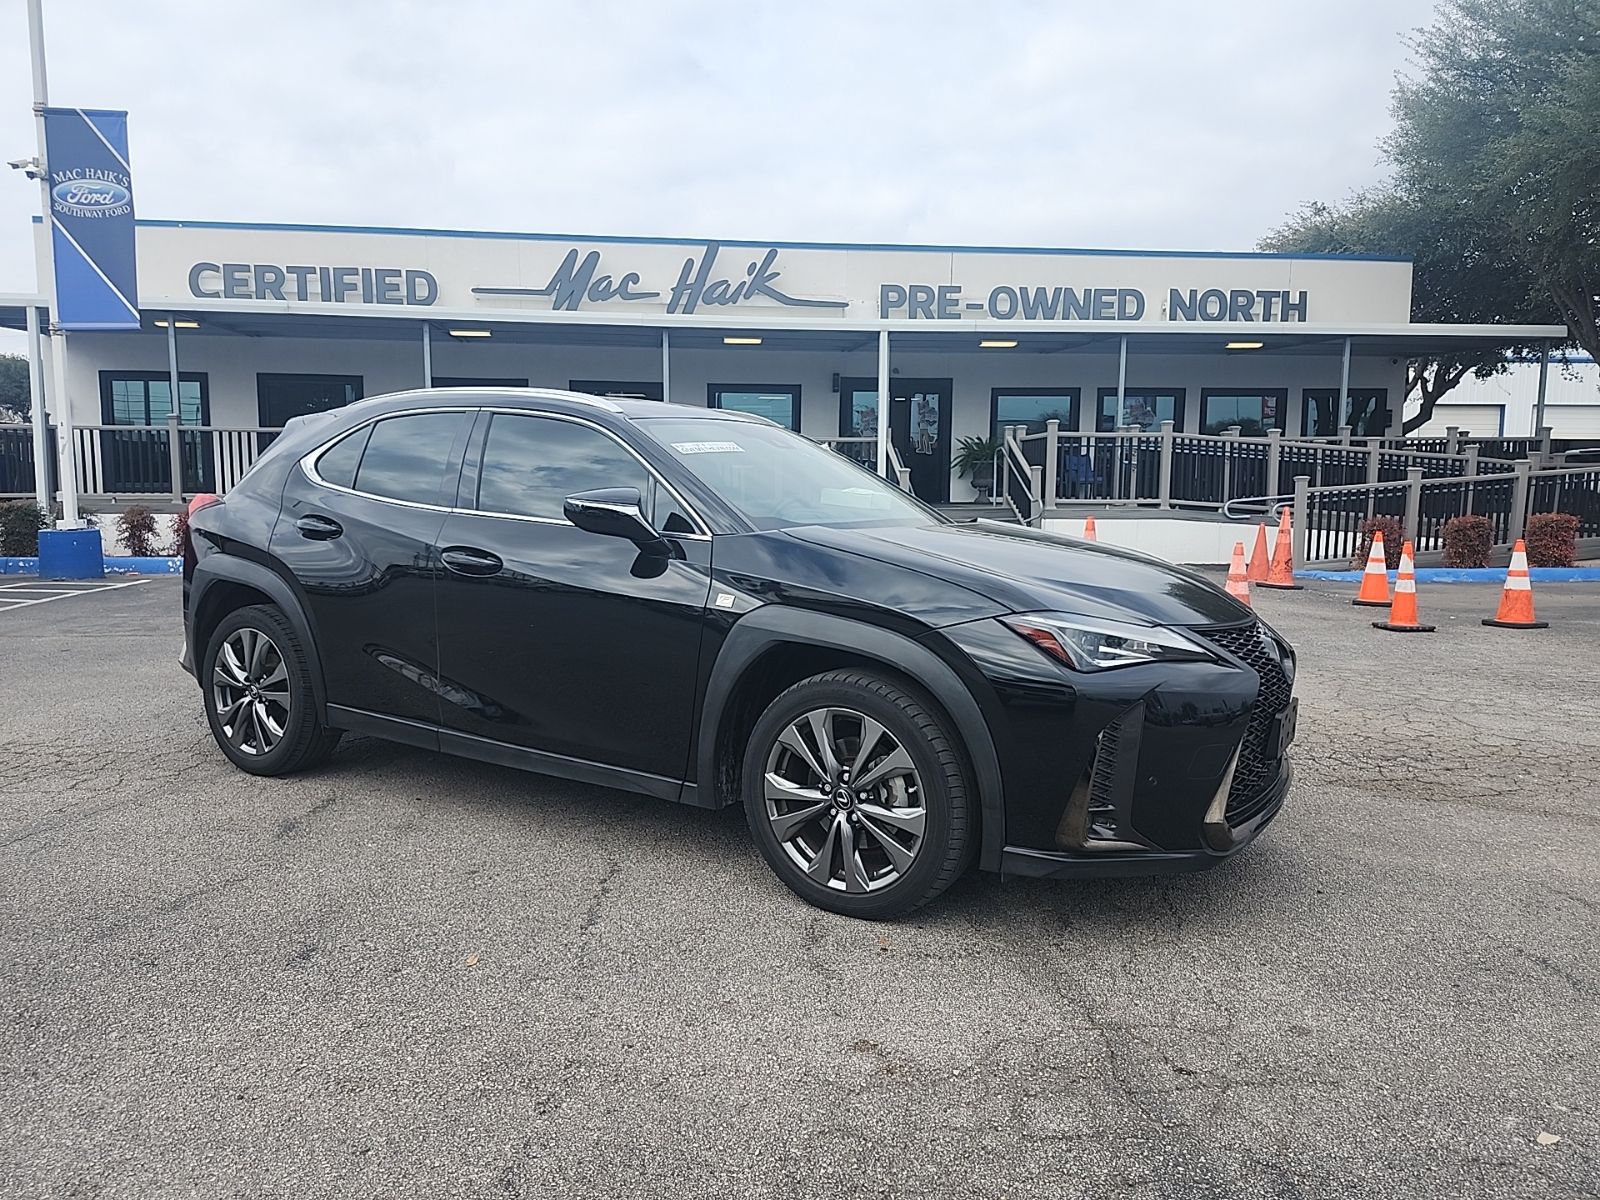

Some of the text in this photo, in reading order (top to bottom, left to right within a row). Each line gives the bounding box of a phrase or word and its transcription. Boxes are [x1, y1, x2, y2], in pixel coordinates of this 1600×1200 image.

[52, 168, 130, 187] MAC HAIK'S
[66, 183, 115, 204] Ford
[53, 202, 131, 218] SOUTHWAY FORD
[188, 262, 439, 307] CERTIFIED
[471, 240, 849, 315] Mac Haik
[879, 284, 1308, 323] PRE-OWNED NORTH
